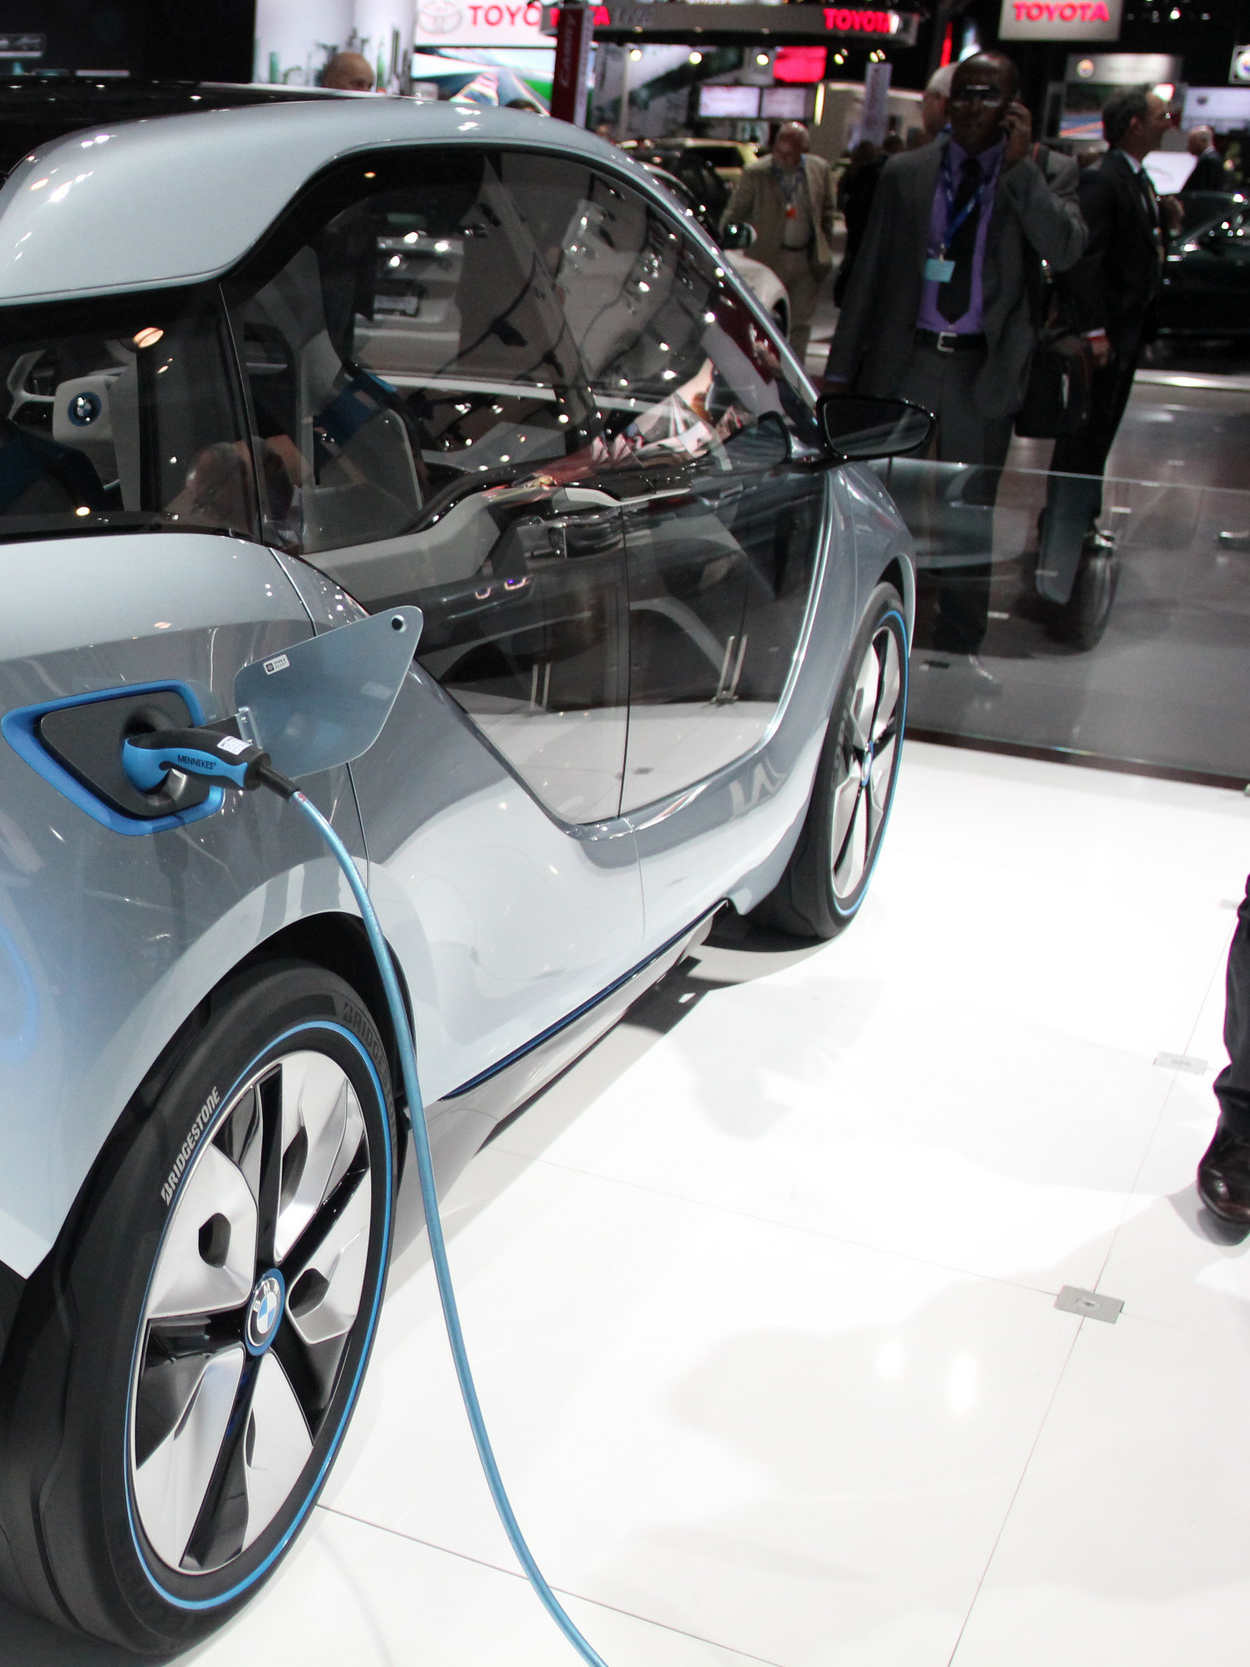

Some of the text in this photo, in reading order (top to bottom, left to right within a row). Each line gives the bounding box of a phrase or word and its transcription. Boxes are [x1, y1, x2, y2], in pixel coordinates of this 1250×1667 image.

[468, 5, 540, 26] TOYO
[1013, 0, 1110, 22] TOYOTA
[160, 1086, 220, 1206] BRIDGESTONE
